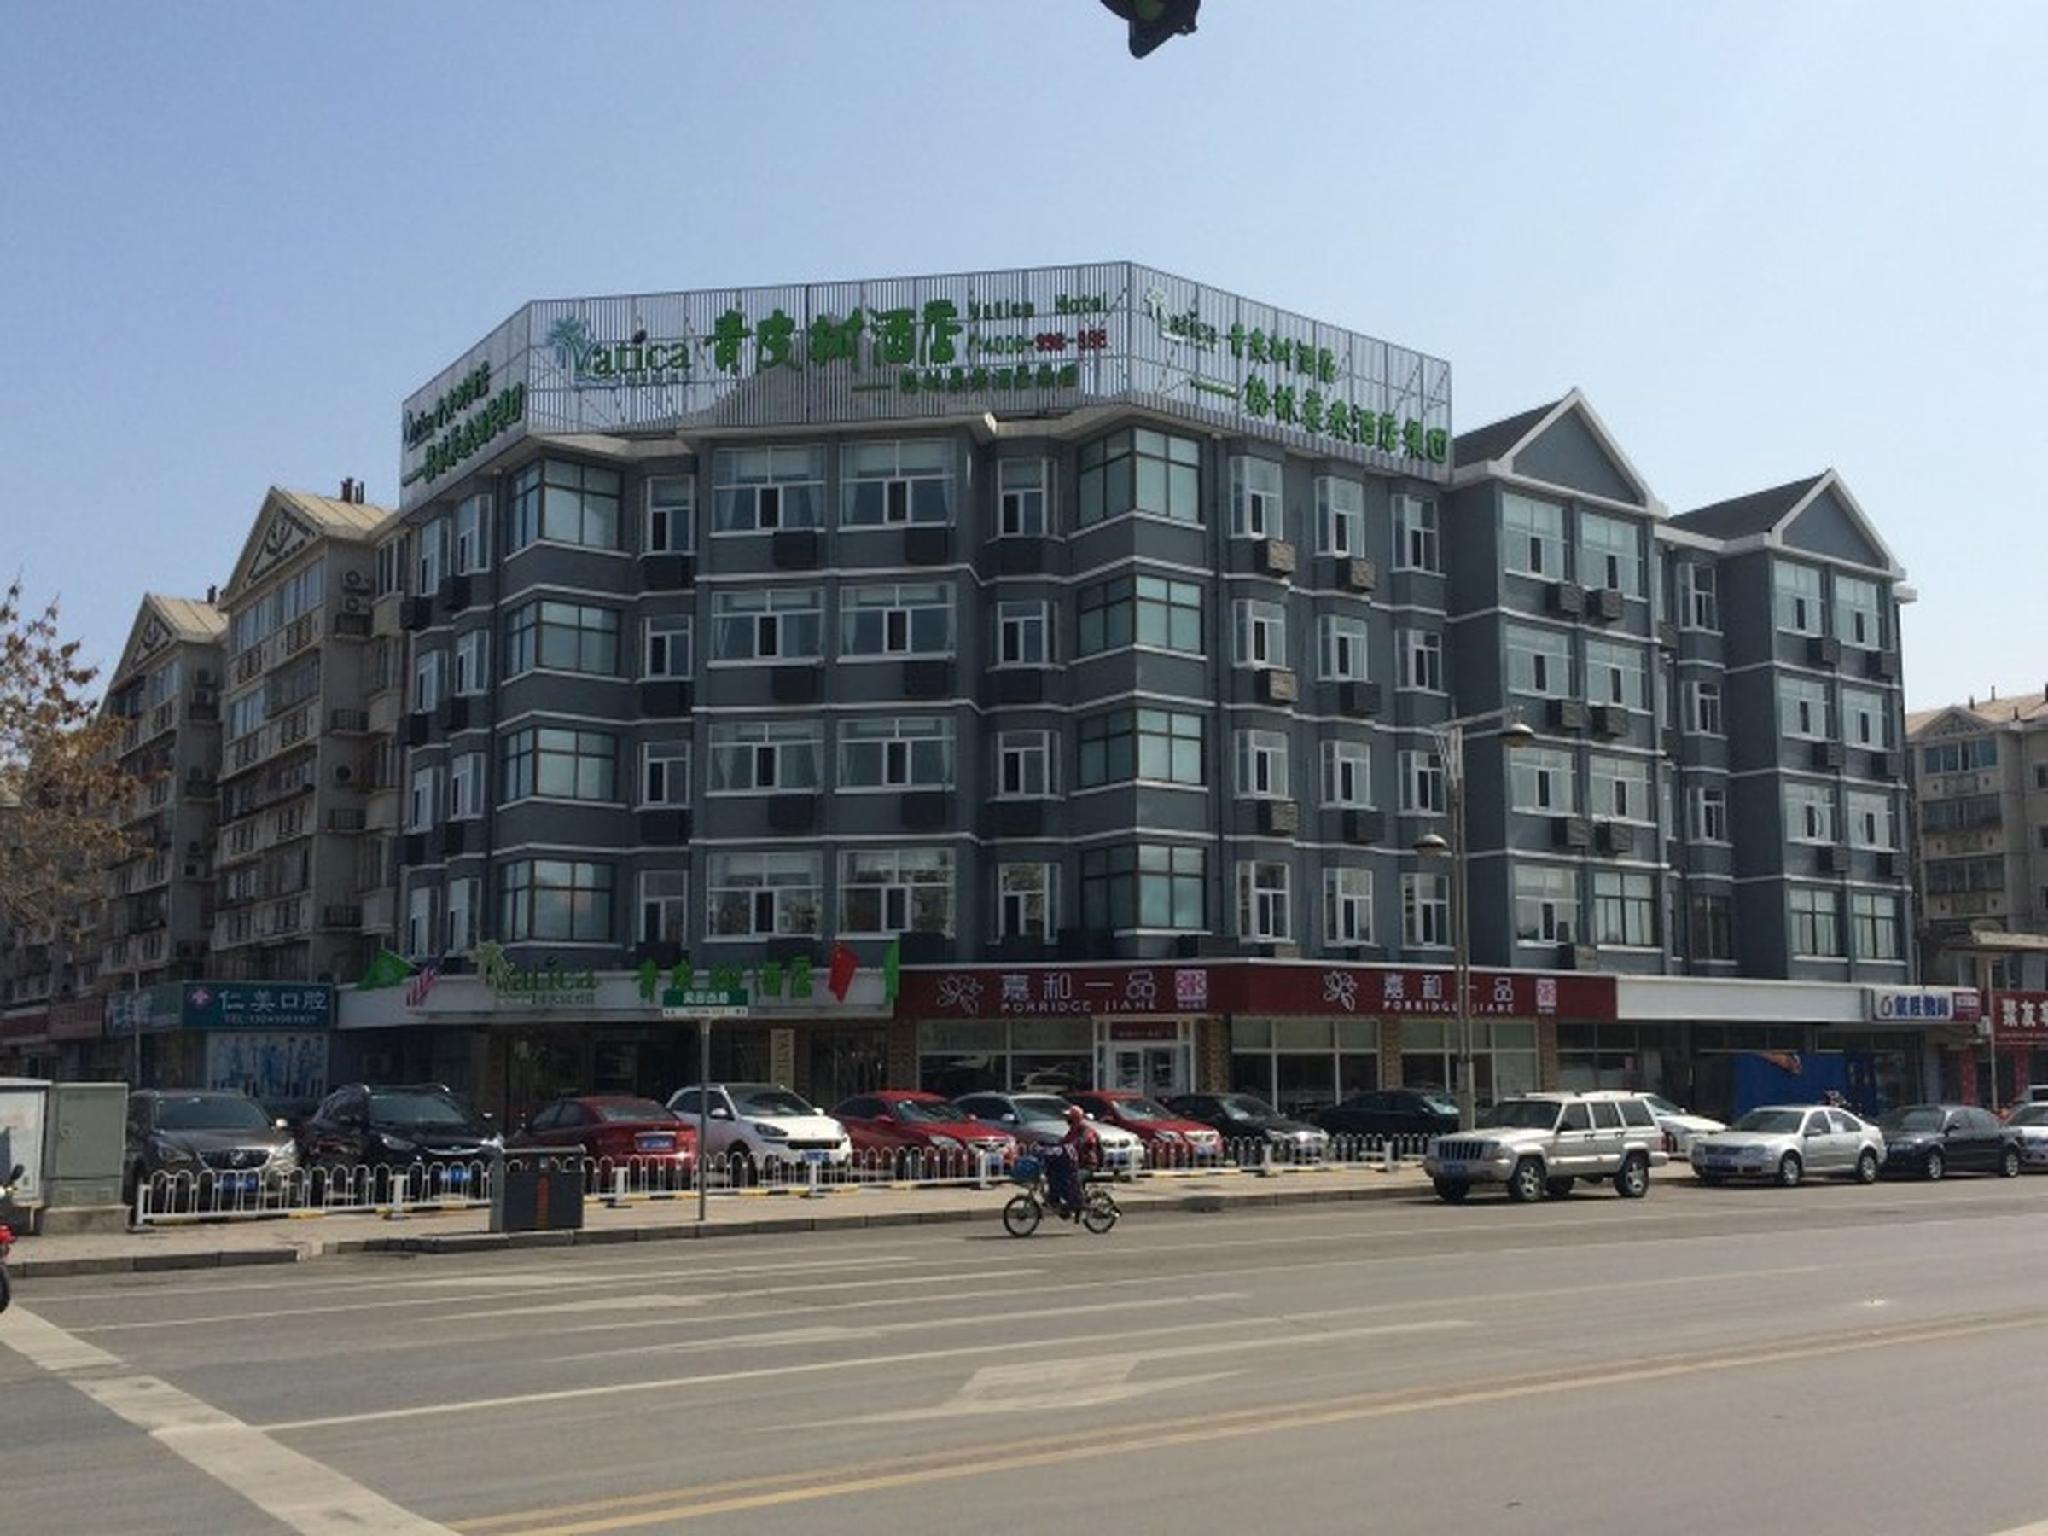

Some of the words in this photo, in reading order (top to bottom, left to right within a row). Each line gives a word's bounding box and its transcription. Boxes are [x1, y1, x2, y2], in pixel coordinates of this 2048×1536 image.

[1055, 291, 1108, 315] Hotel
[703, 299, 962, 376] 青皮树酒店
[1229, 323, 1336, 383] 青皮树酒店
[1002, 969, 1156, 1000] 嘉和一品
[219, 989, 328, 1012] 仁美口腔
